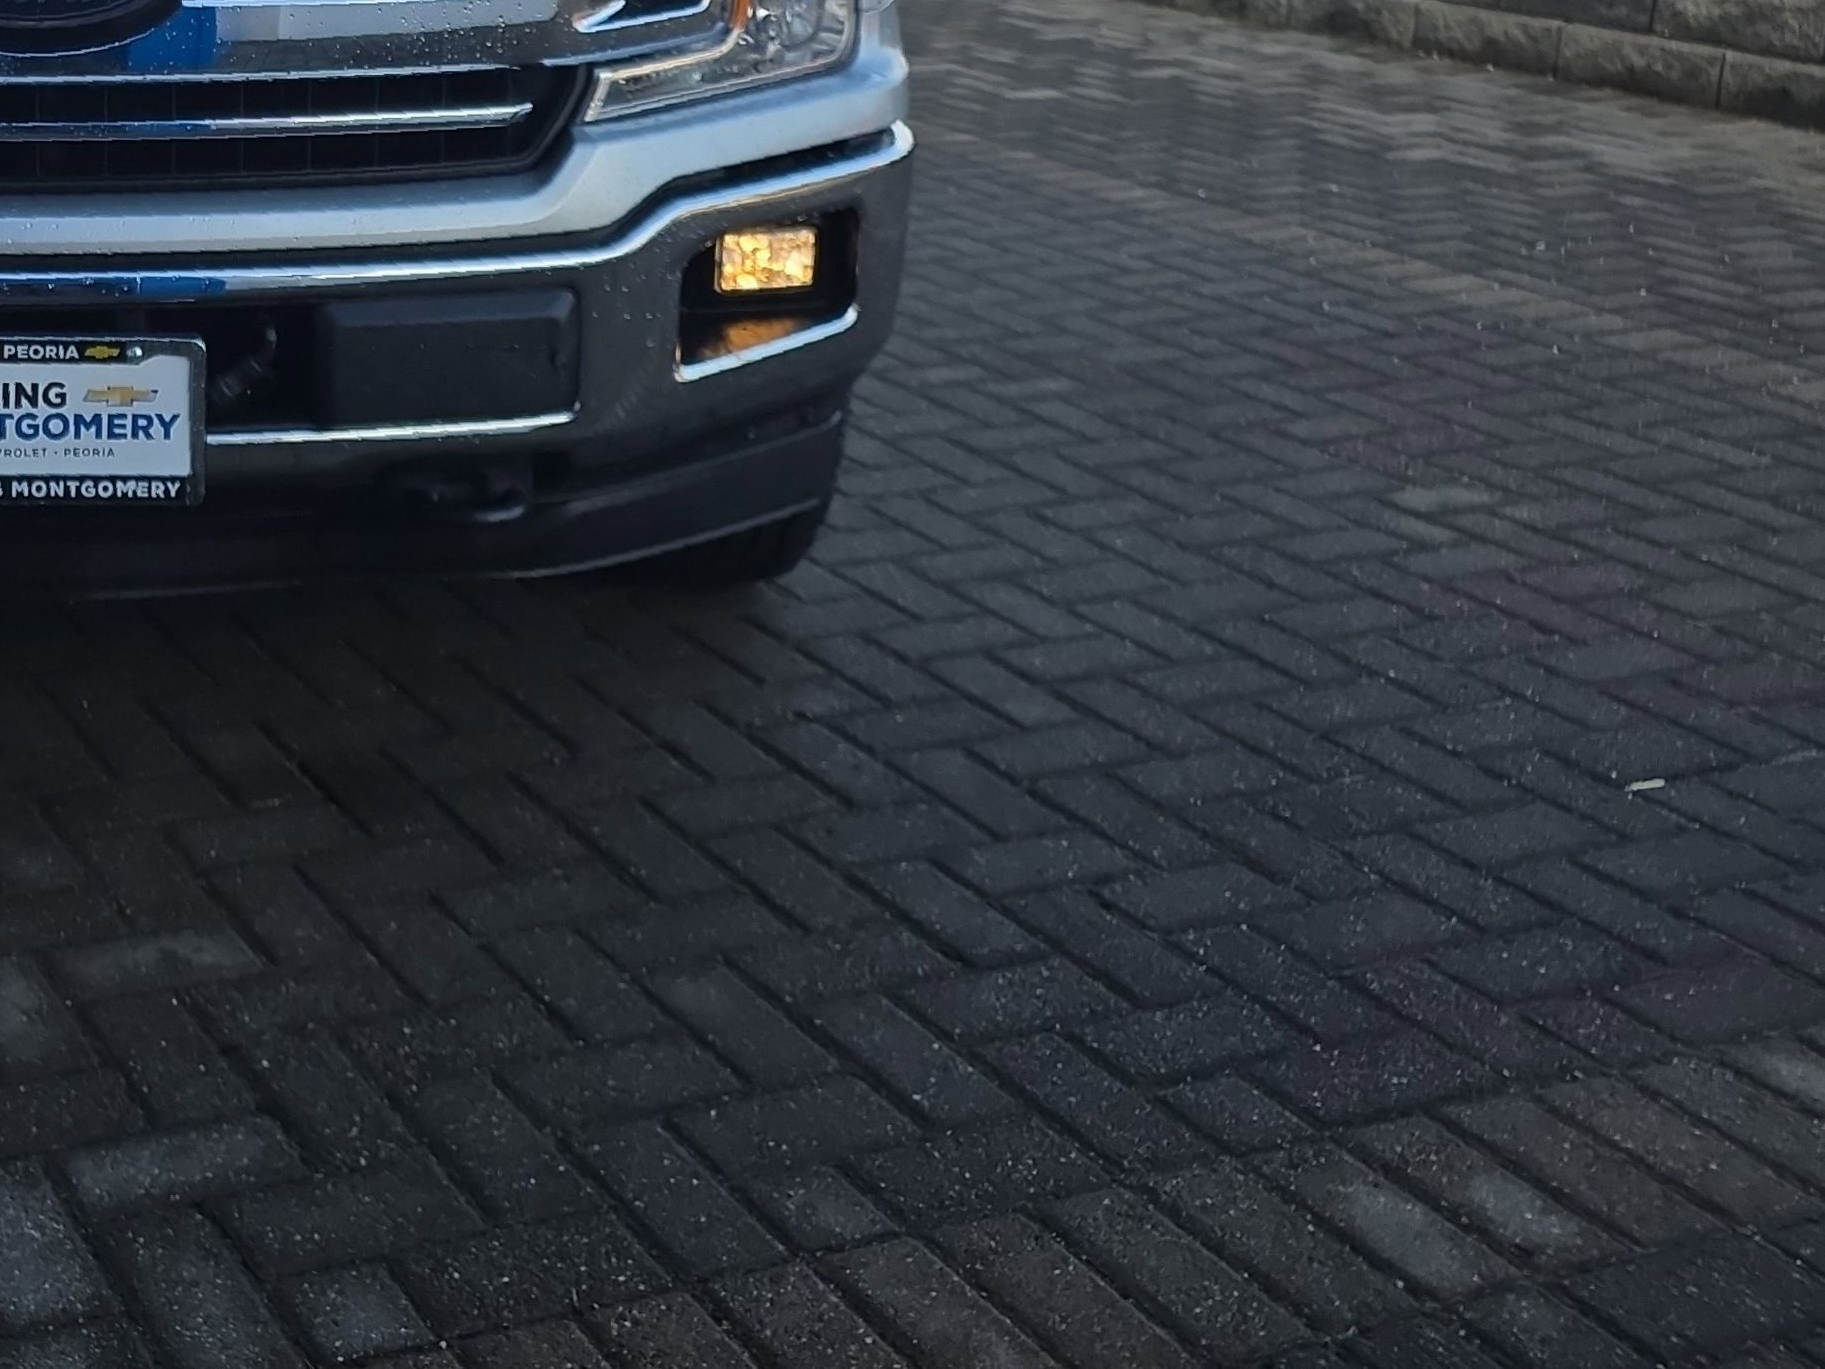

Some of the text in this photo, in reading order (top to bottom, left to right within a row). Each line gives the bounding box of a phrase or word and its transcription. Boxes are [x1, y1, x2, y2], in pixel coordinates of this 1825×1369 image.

[3, 344, 80, 360] PEORIA
[63, 447, 115, 458] PEORIA
[11, 480, 182, 499] MONTGOMERY
